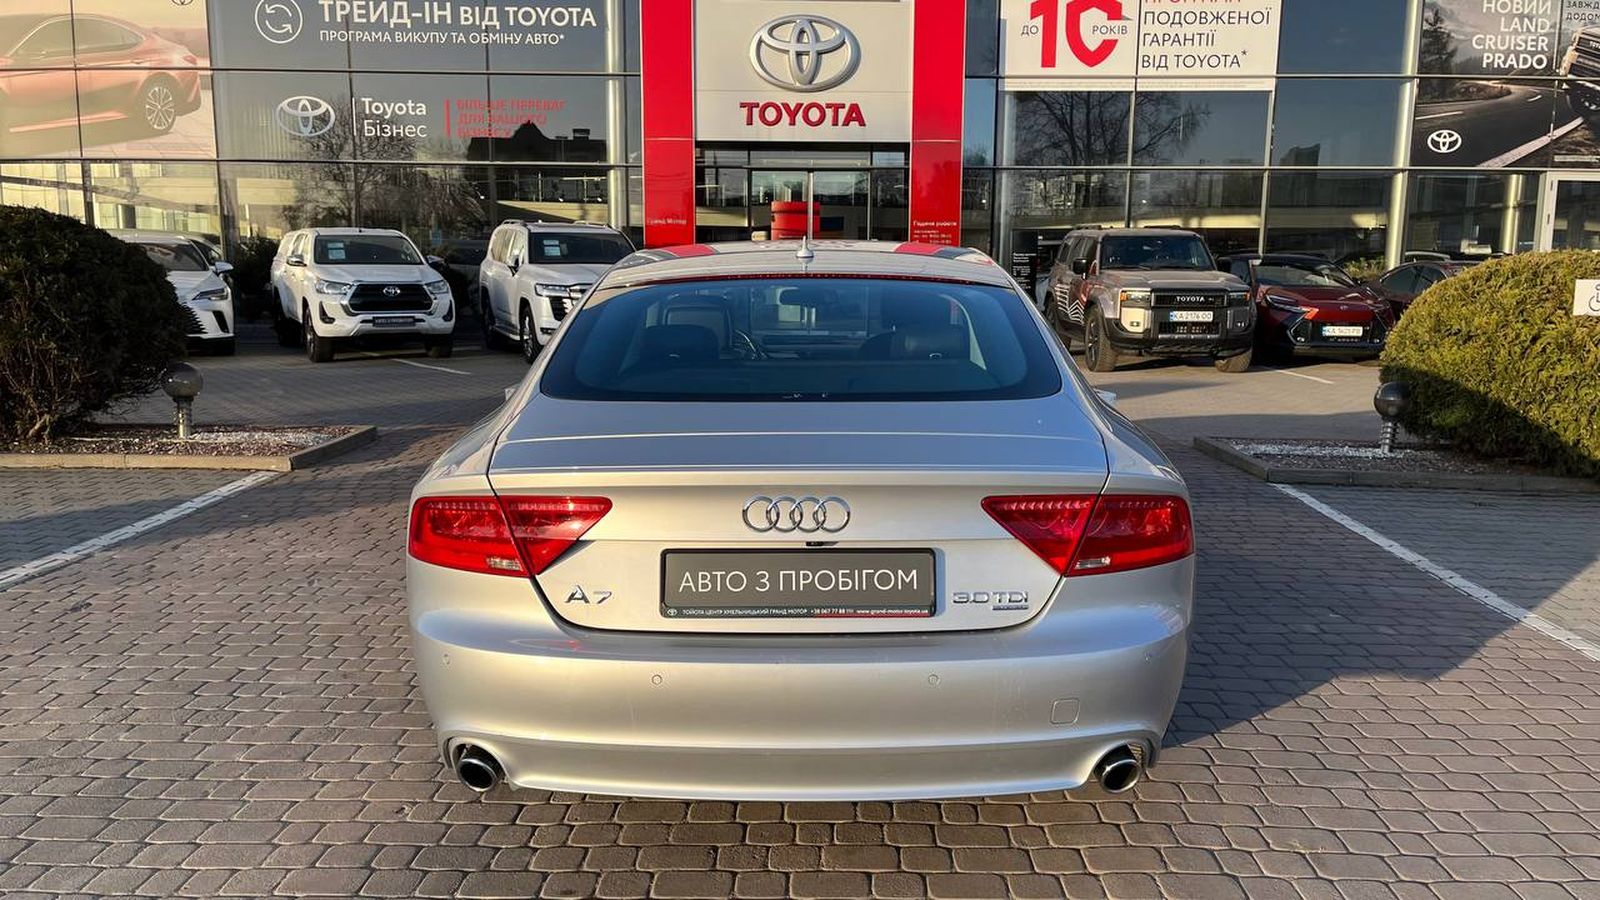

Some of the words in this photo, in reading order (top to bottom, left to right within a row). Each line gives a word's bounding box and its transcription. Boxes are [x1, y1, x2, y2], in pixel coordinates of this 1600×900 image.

[460, 6, 500, 29] ВІД
[505, 7, 597, 27] TOYOTA
[1144, 7, 1272, 27] ПОДОВЖЕНОЇ
[1501, 17, 1550, 33] LAND
[319, 30, 392, 43] ПРОГРАМА
[395, 32, 448, 43] ВИКУПУ
[450, 32, 466, 43] ТА
[469, 32, 522, 44] ОБМІНУ
[1021, 25, 1039, 36] ДО
[1092, 25, 1128, 35] РОКІВ
[1143, 29, 1217, 46] ГАРАНТІЇ
[1472, 34, 1549, 51] CRUISER
[1142, 54, 1168, 70] ВІД
[1482, 53, 1548, 70] PRADO
[361, 98, 427, 119] Toyota
[740, 101, 867, 127] TOYOTA
[364, 120, 428, 138] Бізнес
[679, 571, 747, 592] АВТО
[755, 570, 770, 592] З
[779, 569, 918, 591] ПРОБІГОМ
[682, 608, 705, 616] ТОЙОТА
